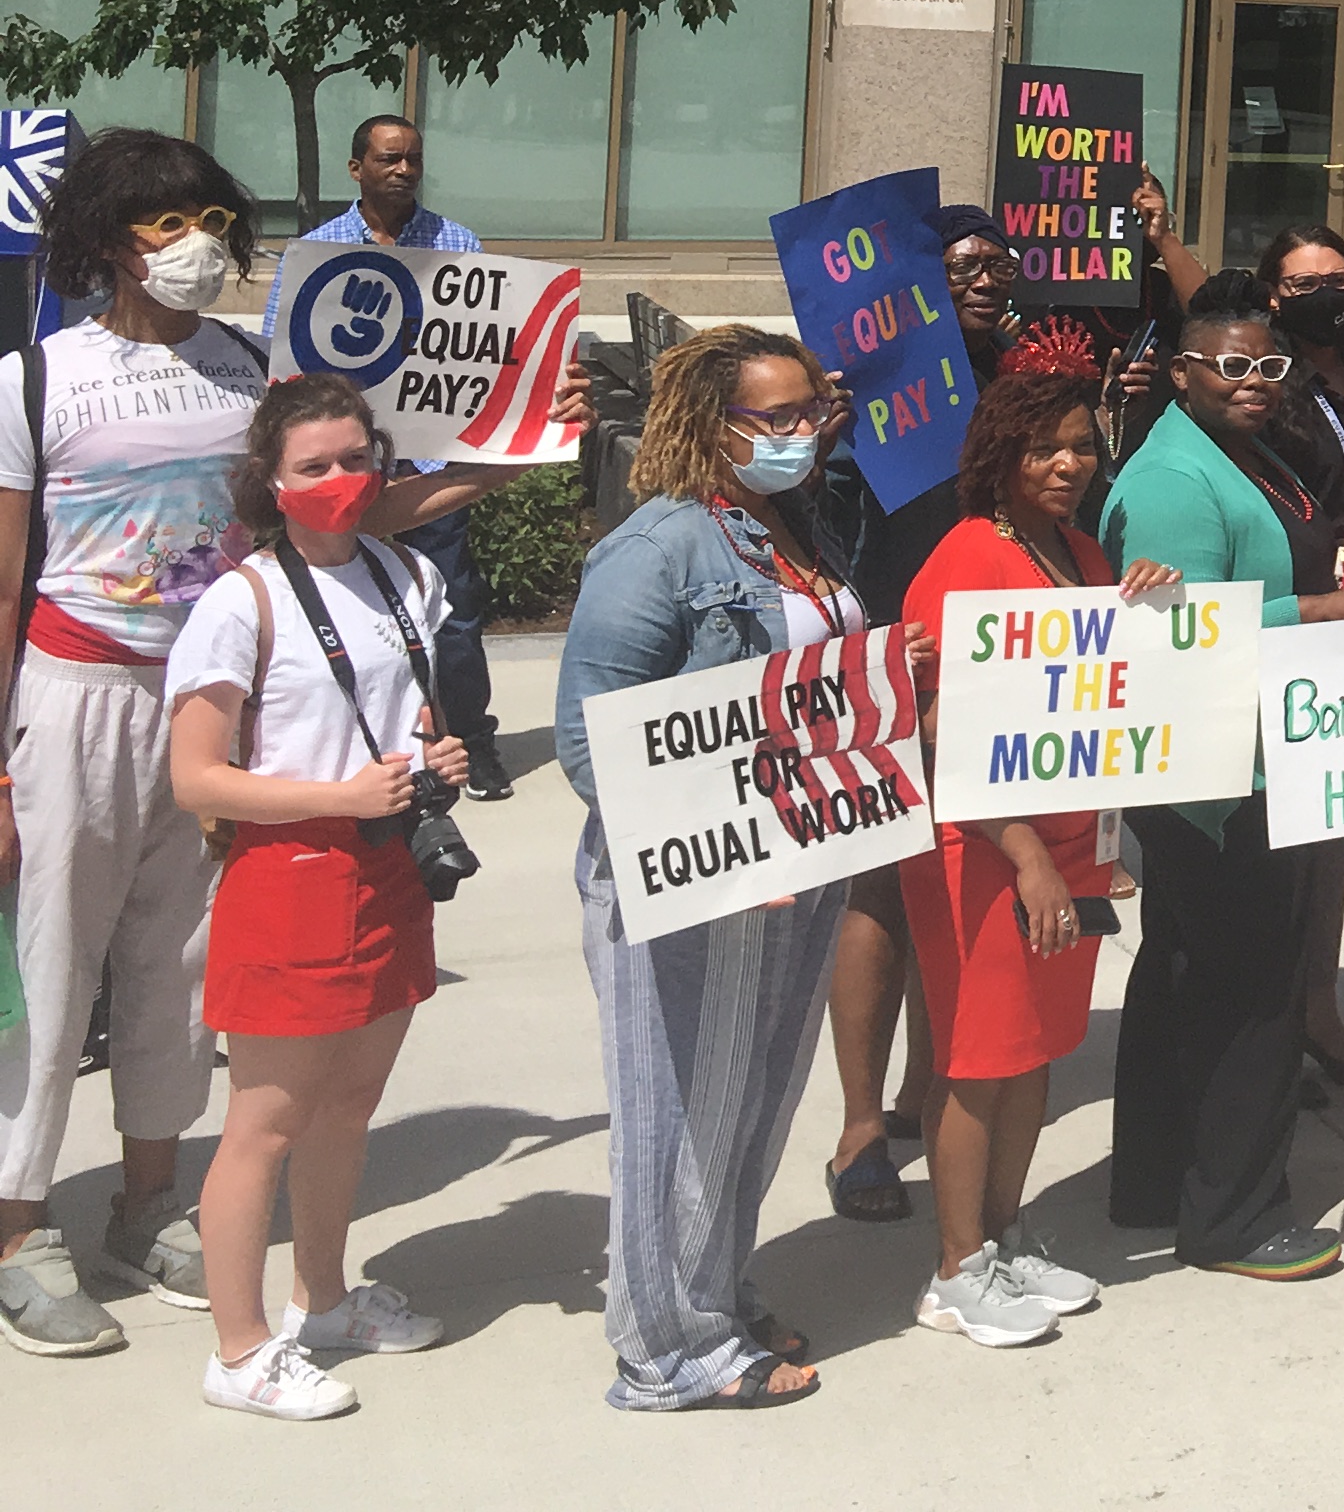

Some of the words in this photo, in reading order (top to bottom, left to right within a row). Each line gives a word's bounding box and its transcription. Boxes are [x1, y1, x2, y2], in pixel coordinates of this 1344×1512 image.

[1018, 81, 1071, 119] I'M
[1015, 122, 1134, 165] WORTH
[1038, 164, 1098, 201] THE
[1003, 201, 1126, 241] WHOLE
[823, 220, 888, 284] GOT
[432, 263, 508, 311] GOT
[401, 317, 519, 366] EQUAL
[832, 284, 940, 366] EQUAL
[69, 380, 105, 397] ice
[112, 359, 256, 387] cream-fueled
[395, 370, 491, 419] PAY?
[970, 607, 1118, 665] SHOW
[1171, 600, 1221, 651] US
[1045, 661, 1127, 712] THE
[644, 701, 771, 768] EQUAL
[784, 669, 850, 728] PAY
[732, 746, 804, 808] FOR
[988, 723, 1172, 785] MONEY!
[637, 828, 773, 898] EQUAL
[784, 773, 911, 848] WORK
